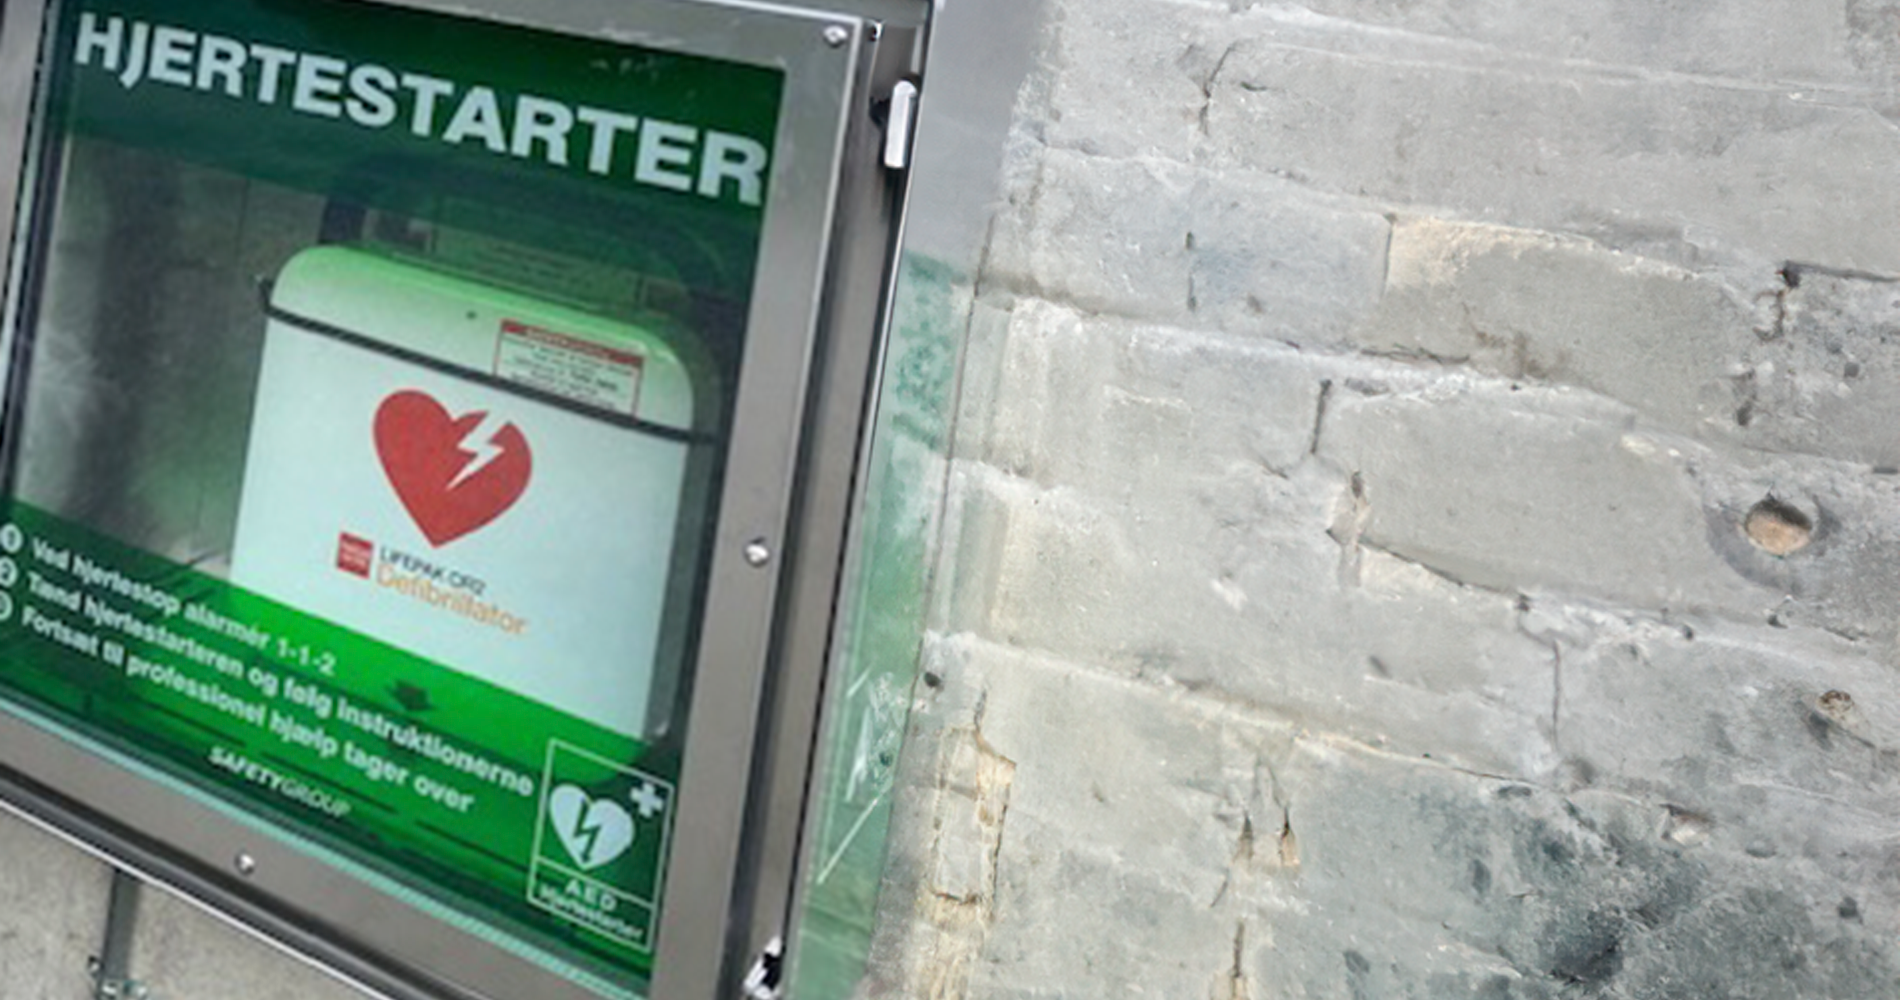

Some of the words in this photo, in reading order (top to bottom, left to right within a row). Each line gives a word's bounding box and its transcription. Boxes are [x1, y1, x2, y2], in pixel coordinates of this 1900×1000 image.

[75, 12, 769, 206] HJERTESTARTER
[72, 554, 181, 616] hjertestop
[277, 639, 336, 676] 1-1-2
[248, 667, 278, 695] og
[102, 641, 124, 666] til
[343, 741, 409, 785] tager
[414, 775, 474, 814] over
